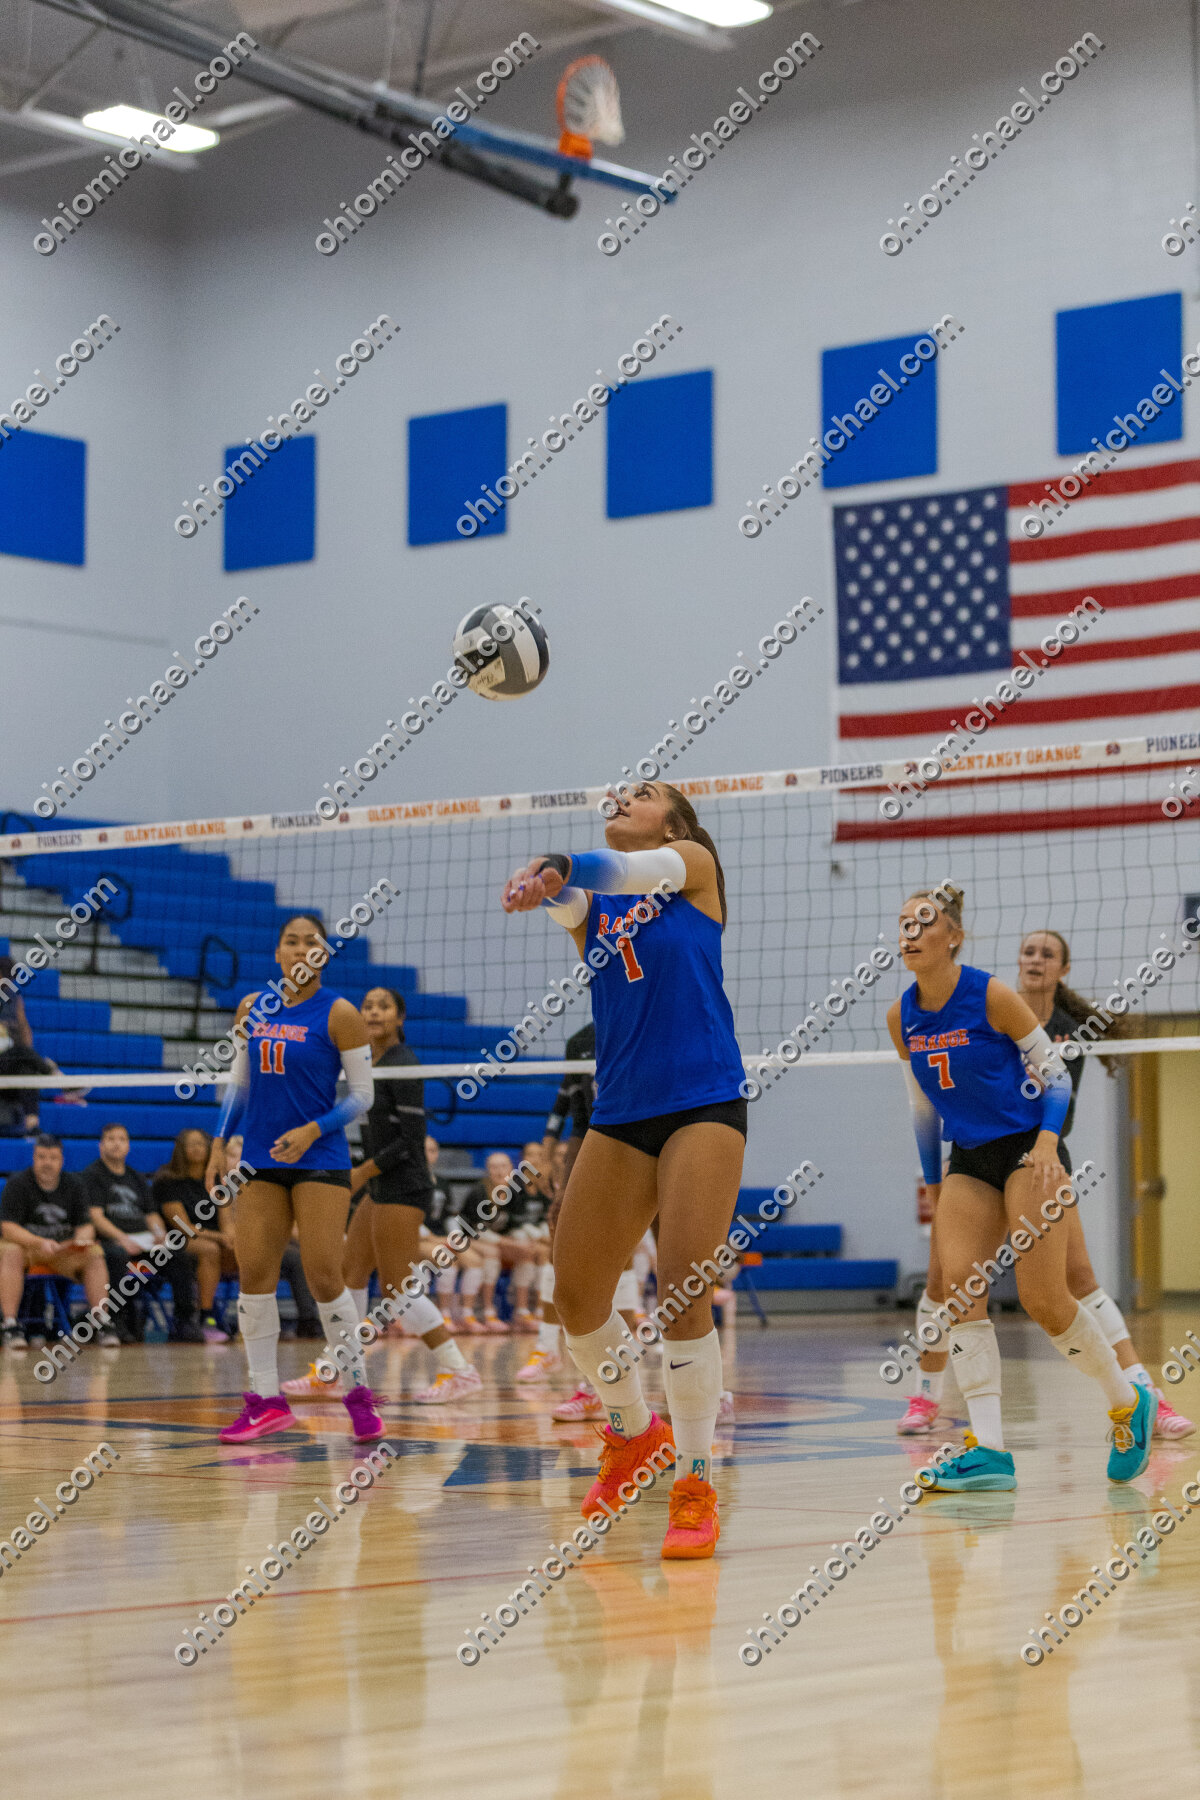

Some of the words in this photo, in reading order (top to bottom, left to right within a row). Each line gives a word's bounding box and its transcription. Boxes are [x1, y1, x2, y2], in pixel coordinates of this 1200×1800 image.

[1027, 745, 1082, 764] ORANGE
[820, 764, 883, 784] PIONEERS
[714, 776, 764, 793] ORANGE
[531, 791, 587, 809] PIONEERS
[368, 803, 433, 822] OLENTANGY
[616, 935, 644, 983] 1
[909, 1029, 970, 1053] ORANGE
[259, 1039, 286, 1075] 11
[927, 1051, 956, 1090] 7
